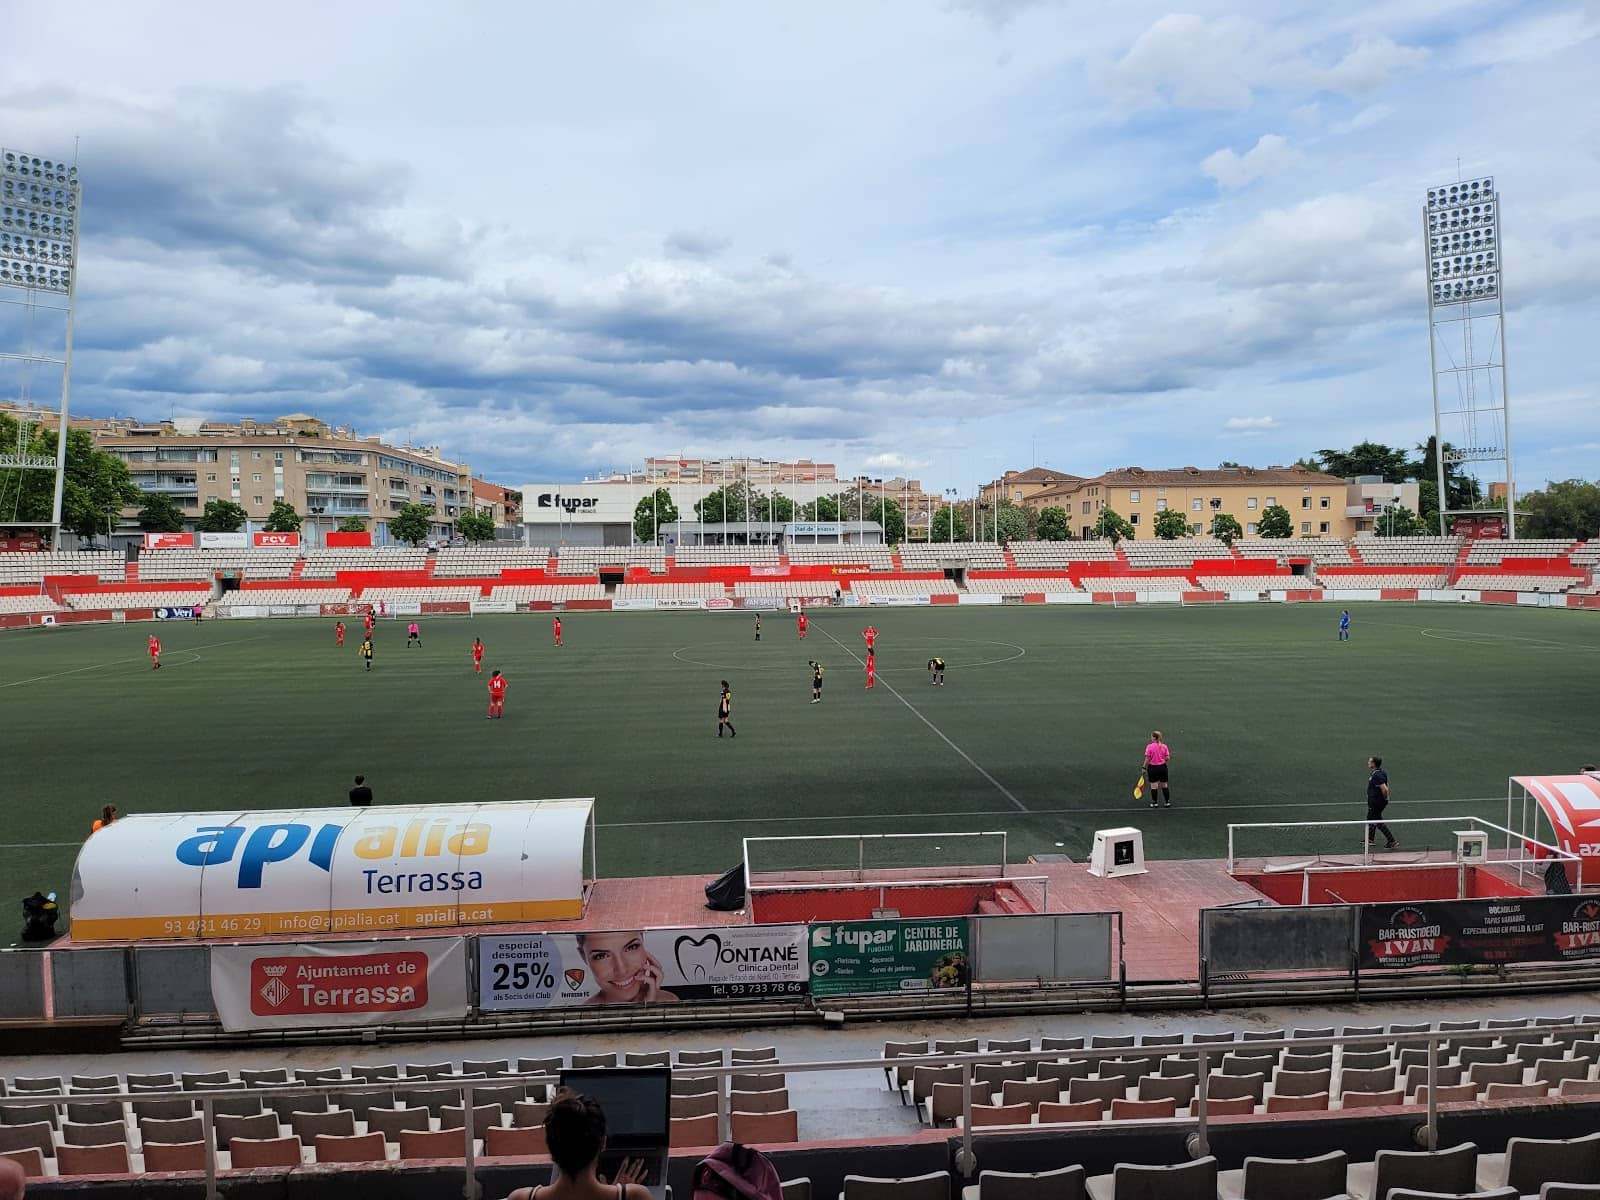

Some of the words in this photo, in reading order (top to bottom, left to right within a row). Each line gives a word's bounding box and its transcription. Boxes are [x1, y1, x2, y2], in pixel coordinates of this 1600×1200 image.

[554, 494, 599, 512] fupar
[262, 535, 287, 543] FCV
[494, 680, 501, 689] 14
[362, 869, 482, 894] Terrassa
[164, 920, 182, 933] 93
[187, 919, 216, 932] 481
[220, 918, 239, 930] 46
[243, 917, 261, 929] 29
[279, 911, 400, 929] info@apialia.cat
[415, 908, 494, 927] apialia.cat
[835, 925, 897, 953] fupar
[904, 927, 943, 940] CENTRE
[945, 926, 959, 938] DE
[1378, 925, 1441, 940] BAR-RUSTIDERO
[498, 941, 542, 951] especial
[867, 945, 894, 953] FUNDACIÓ
[904, 938, 963, 953] JARDINERIA
[1384, 938, 1436, 955] IVAN
[492, 951, 550, 960] descompte
[296, 962, 390, 981] Ajuntament
[396, 961, 417, 974] de
[769, 962, 799, 972] Dental
[493, 962, 555, 991] 25%
[296, 984, 416, 1007] Terrassa
[493, 993, 503, 1001] als
[535, 991, 551, 999] Club
[712, 985, 729, 995] Tel.
[731, 984, 745, 994] 93
[748, 984, 768, 993] 733
[771, 983, 785, 993] 78
[787, 982, 801, 992] 66
